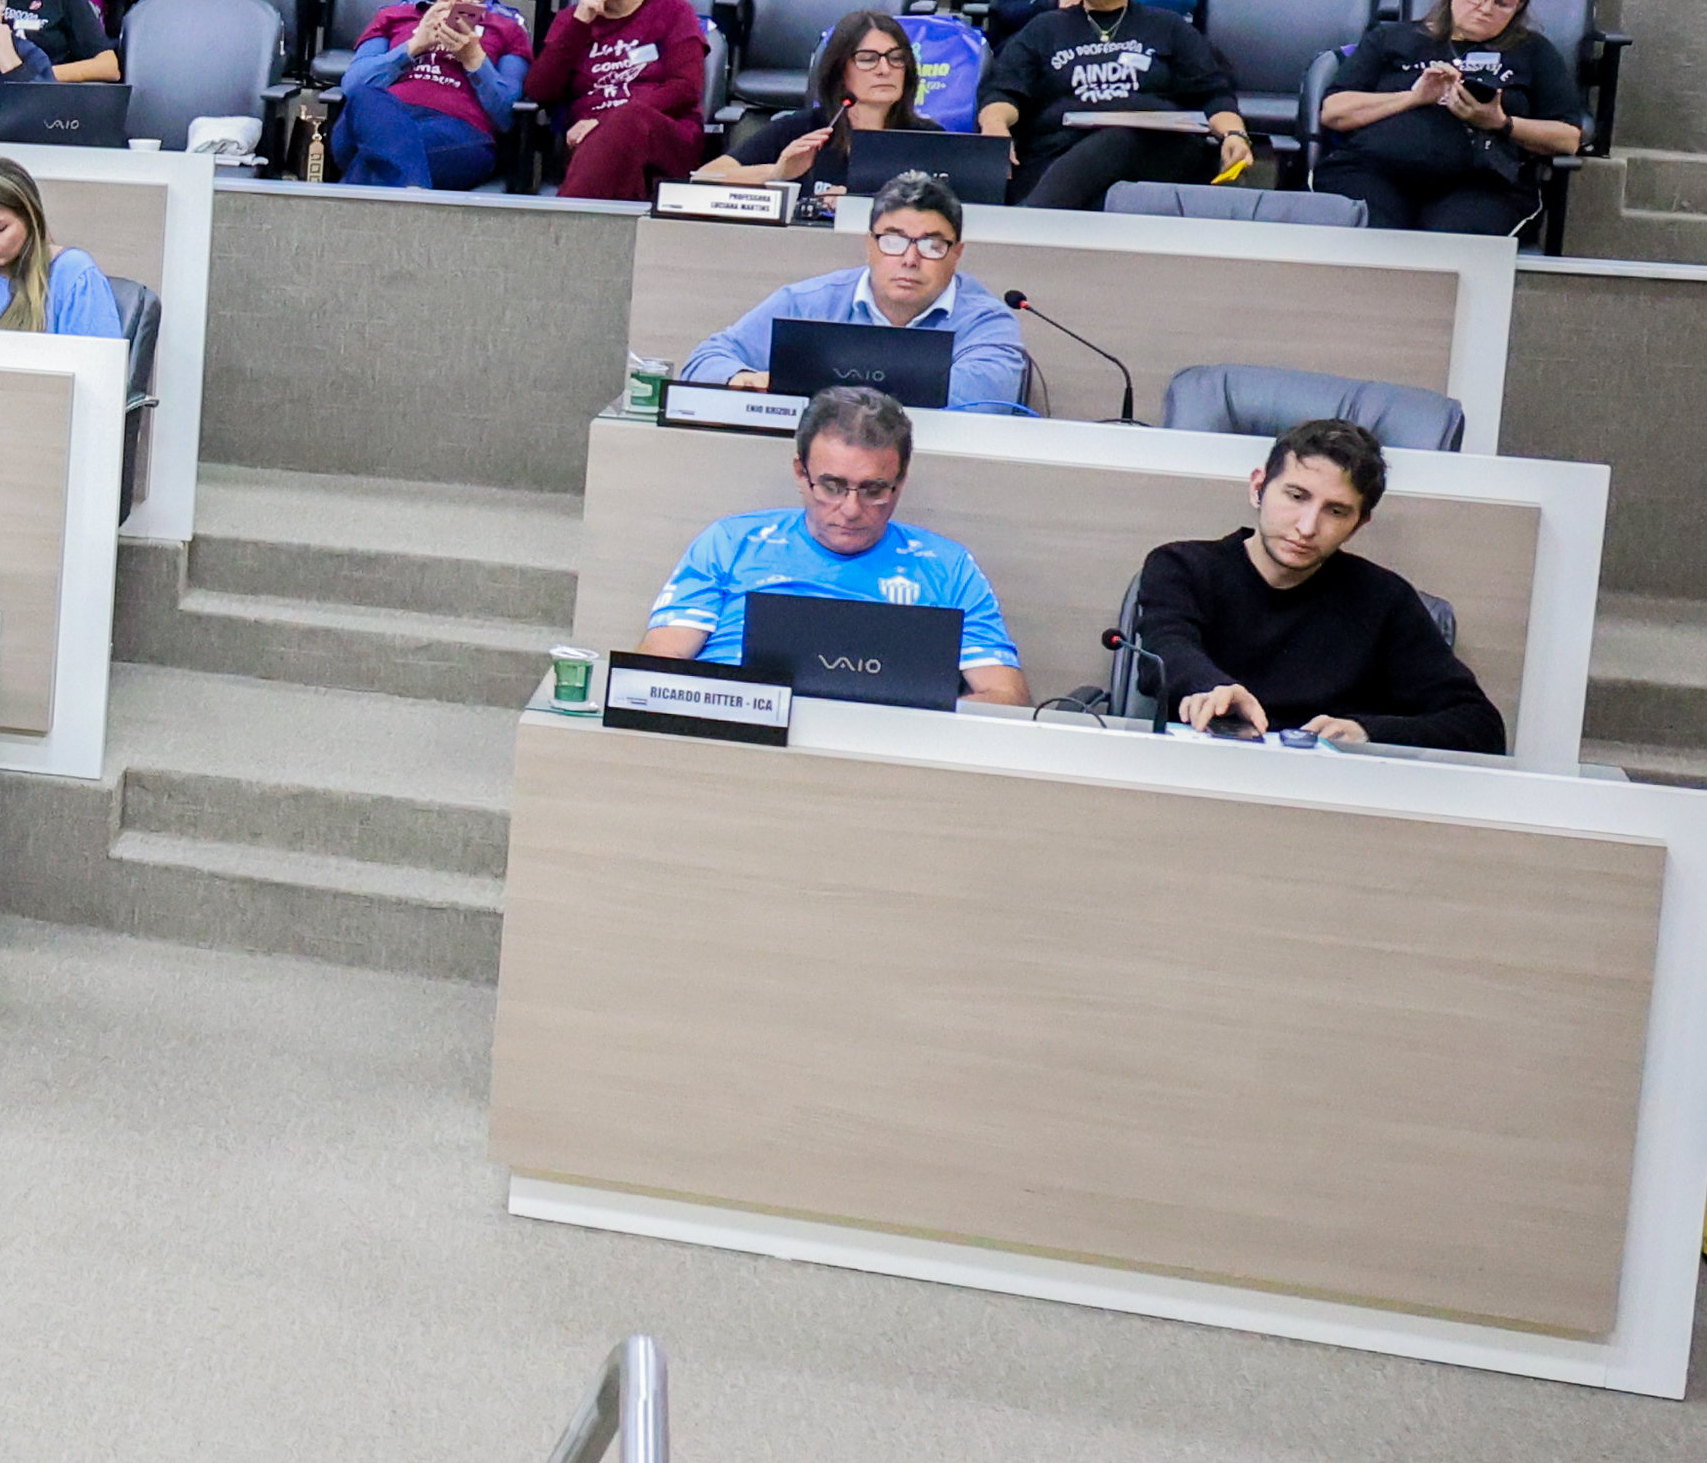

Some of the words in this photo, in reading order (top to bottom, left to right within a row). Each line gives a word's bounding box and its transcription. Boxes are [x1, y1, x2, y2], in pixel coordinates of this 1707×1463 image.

[591, 59, 632, 73] como
[1051, 48, 1075, 70] SOU
[1072, 61, 1137, 87] AINDA
[44, 119, 80, 131] VAIO
[832, 367, 886, 382] VAIO
[745, 403, 763, 414] ENIO
[765, 405, 797, 417] BRIZOLA
[818, 654, 881, 674] VAIO
[650, 686, 701, 703] RICARDO
[703, 692, 743, 709] RITTER
[752, 699, 773, 712] ICA
